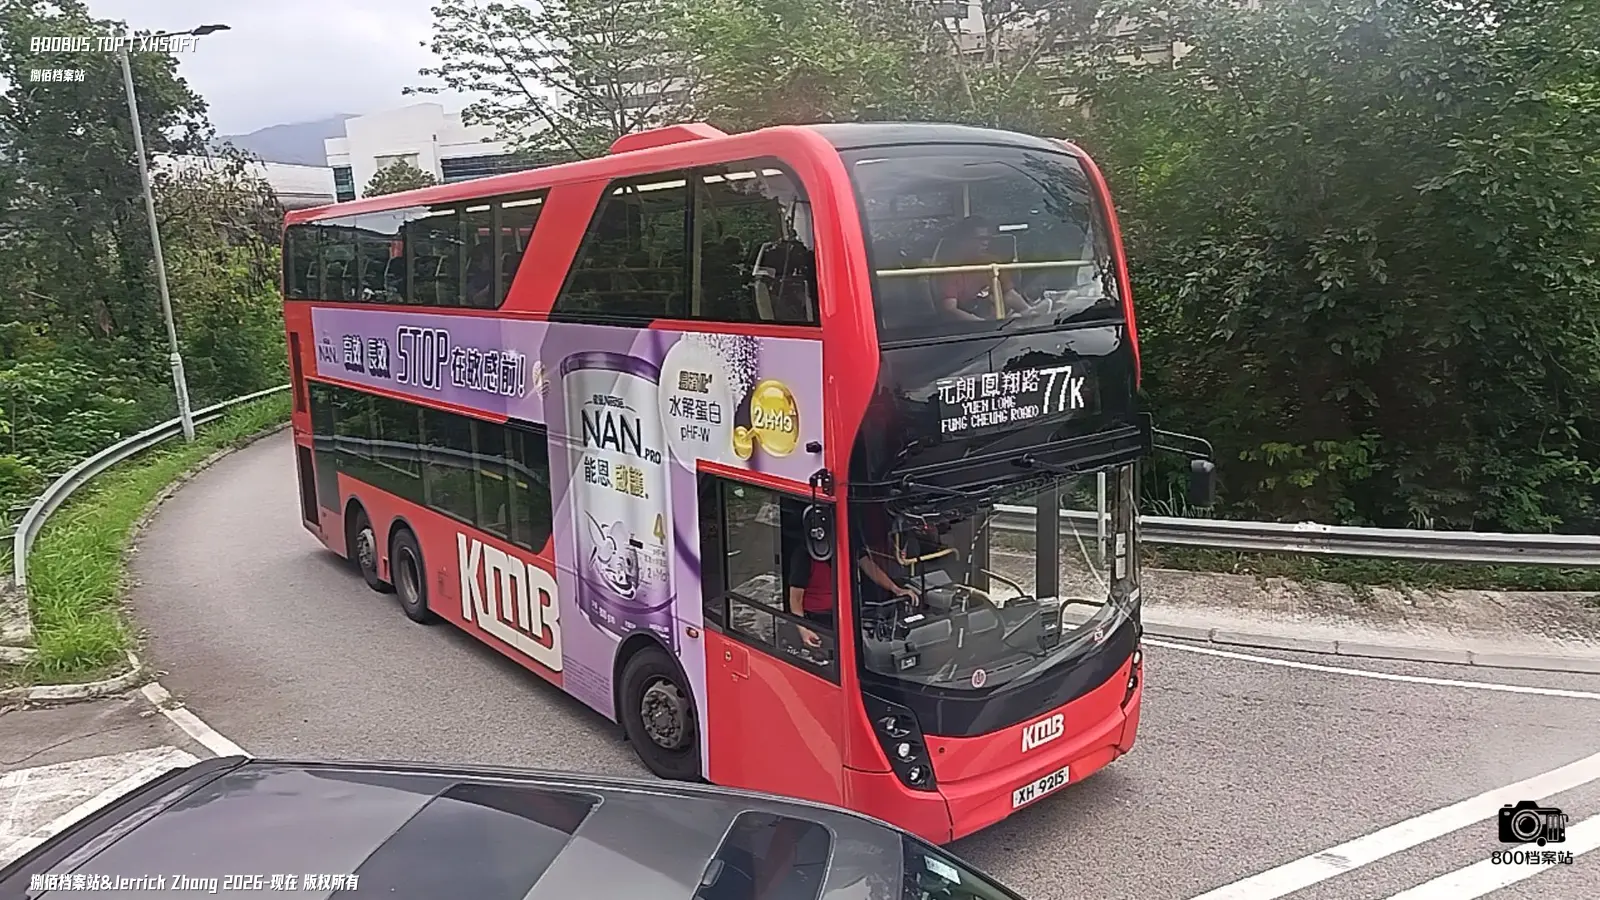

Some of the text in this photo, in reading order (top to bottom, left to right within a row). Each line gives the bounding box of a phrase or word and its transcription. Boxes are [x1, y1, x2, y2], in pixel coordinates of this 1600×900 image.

[397, 326, 450, 390] STOP
[936, 377, 975, 404] 元朗
[1040, 366, 1085, 414] 77K
[961, 396, 1016, 415] YUEN LONG
[669, 395, 721, 424] 水解蛋白
[971, 410, 1007, 428] CHEUNG
[581, 409, 661, 465] NAN PRO
[681, 425, 710, 442] pHF-W
[653, 513, 665, 545] 4
[457, 532, 563, 672] KMB
[1021, 713, 1064, 752] KMB
[1018, 770, 1064, 804] XH 9215
